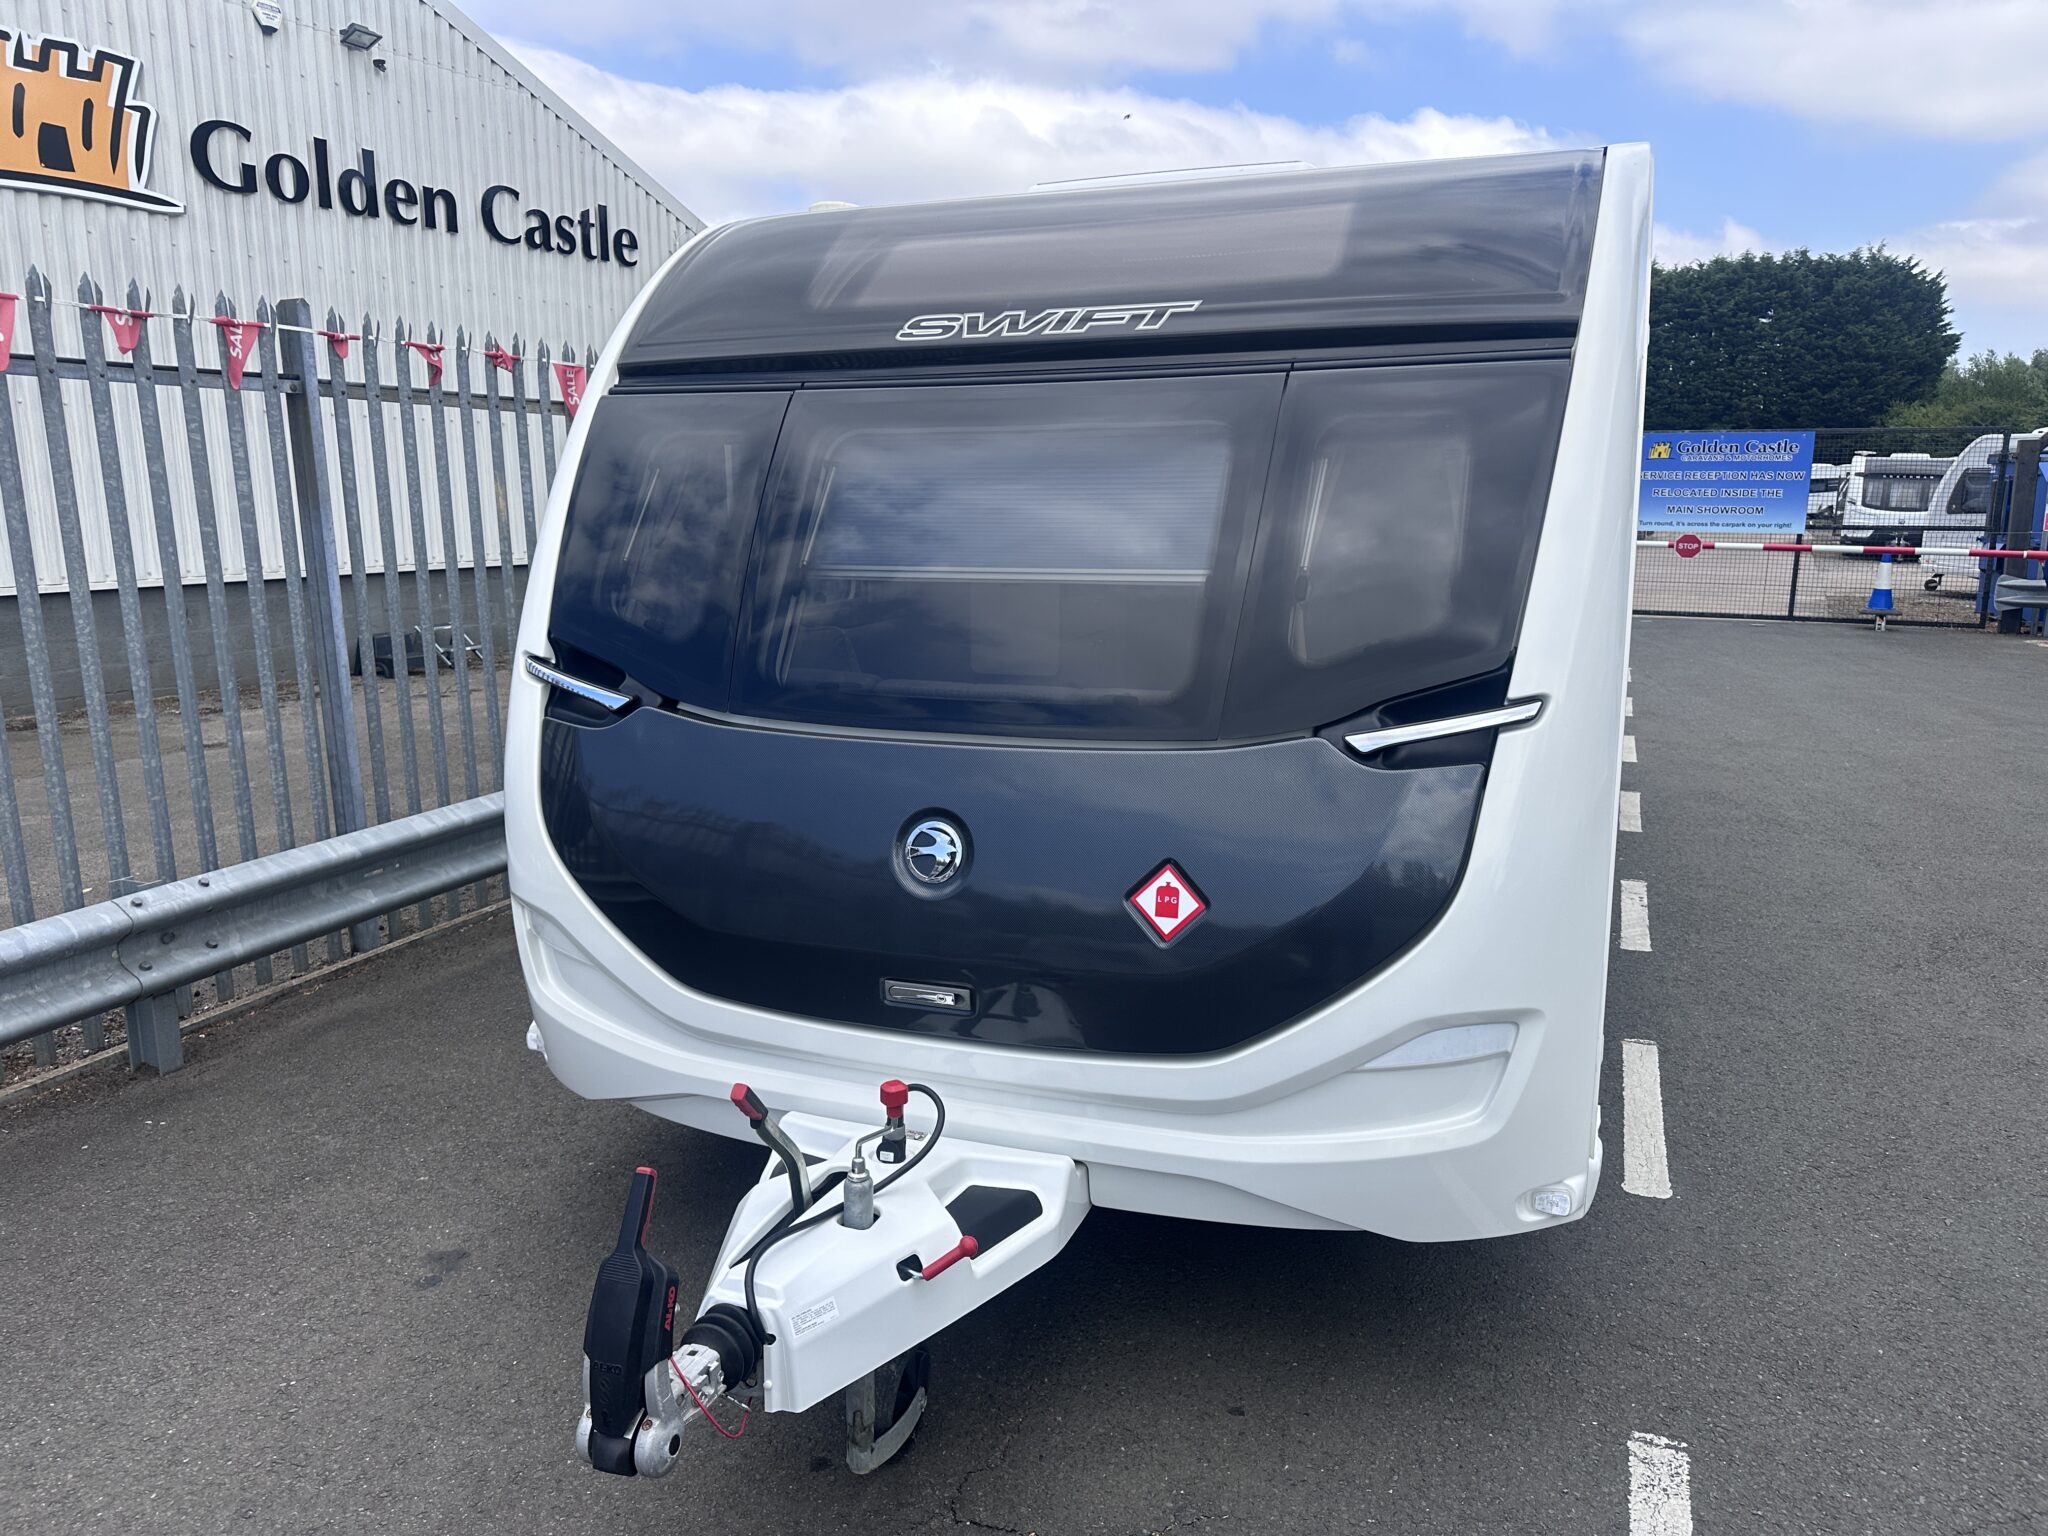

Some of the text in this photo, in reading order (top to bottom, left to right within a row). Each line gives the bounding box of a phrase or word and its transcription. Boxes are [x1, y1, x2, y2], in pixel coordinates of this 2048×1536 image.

[190, 119, 639, 268] Golden Castle
[896, 300, 1203, 341] SWIFT
[566, 369, 580, 405] SALE
[1677, 439, 1800, 454] Golden Castle
[1684, 471, 1748, 480] RECEPTION
[1750, 471, 1774, 480] HAS
[1776, 471, 1805, 480] NOW
[1652, 488, 1783, 498] RELOCATED INSIDE THE
[1666, 505, 1764, 515] MAIN SHOWROOM
[1157, 896, 1178, 904] LPG
